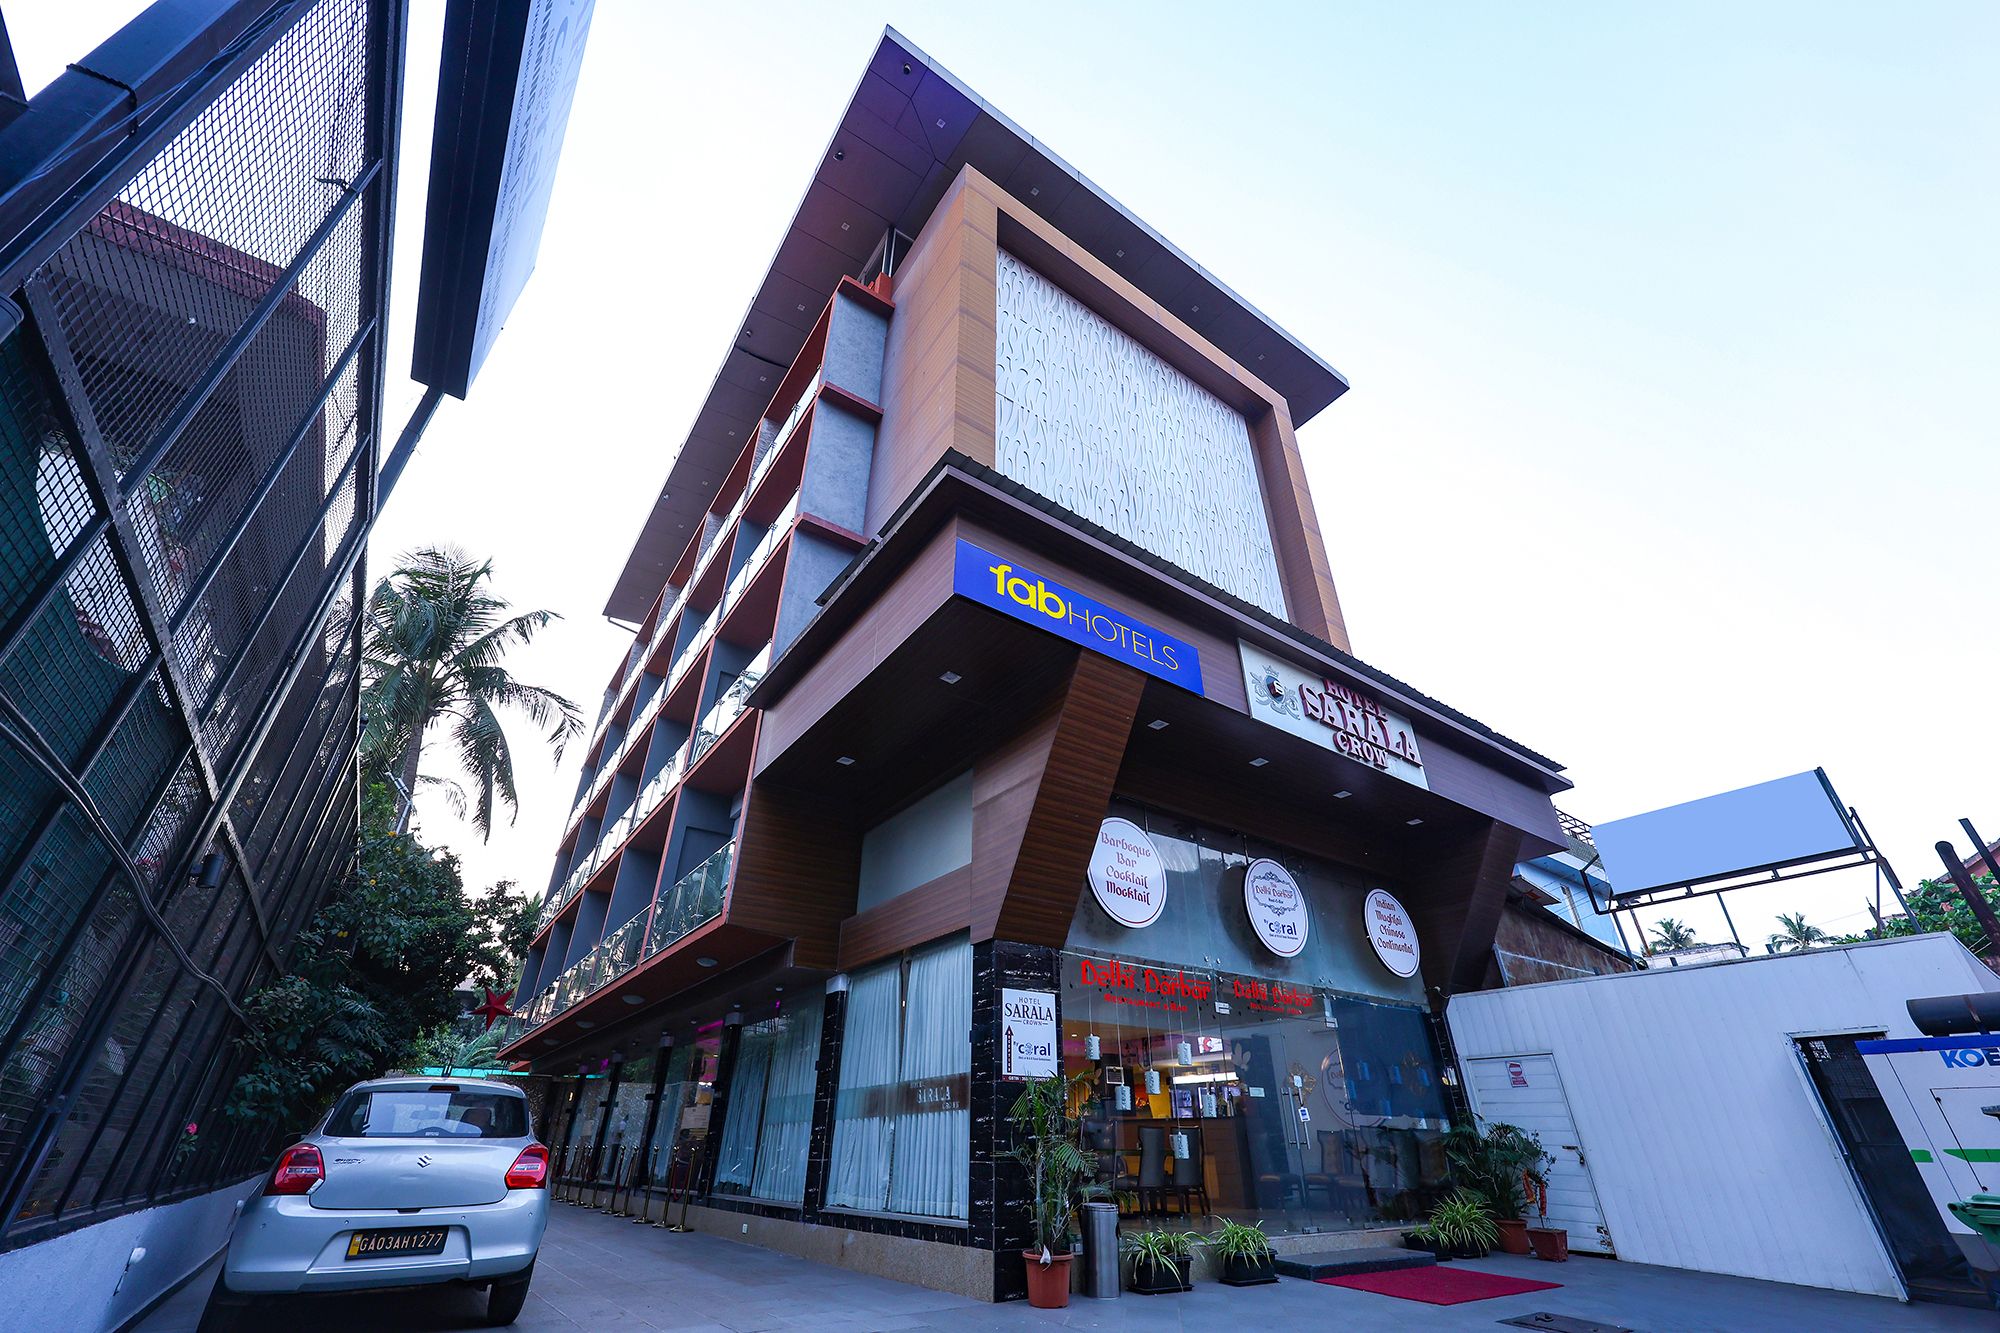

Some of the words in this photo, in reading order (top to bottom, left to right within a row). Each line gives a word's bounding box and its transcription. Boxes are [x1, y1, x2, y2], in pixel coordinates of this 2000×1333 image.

[989, 564, 1067, 619] fab
[1068, 601, 1179, 671] HOTELS
[1322, 678, 1389, 722] HOTEL
[1299, 683, 1424, 767] SARALA
[1101, 831, 1151, 858] Barbeque
[1116, 852, 1137, 868] Bar
[1106, 865, 1148, 889] Cocktail
[1106, 880, 1150, 906] Mocktail
[1255, 885, 1271, 896] Delhi
[1271, 888, 1293, 899] Darbar
[1375, 897, 1396, 912] Indian
[1379, 924, 1406, 940] Chinese
[1377, 936, 1415, 956] Continental
[1081, 959, 1136, 990] Delhi
[1144, 967, 1211, 1001] Darbar
[1019, 997, 1041, 1006] HOTEL
[1233, 977, 1267, 1001] Delhi
[1271, 985, 1313, 1008] Darbar
[1005, 1003, 1054, 1021] SARALA
[359, 1233, 444, 1252] GA03AH1277
